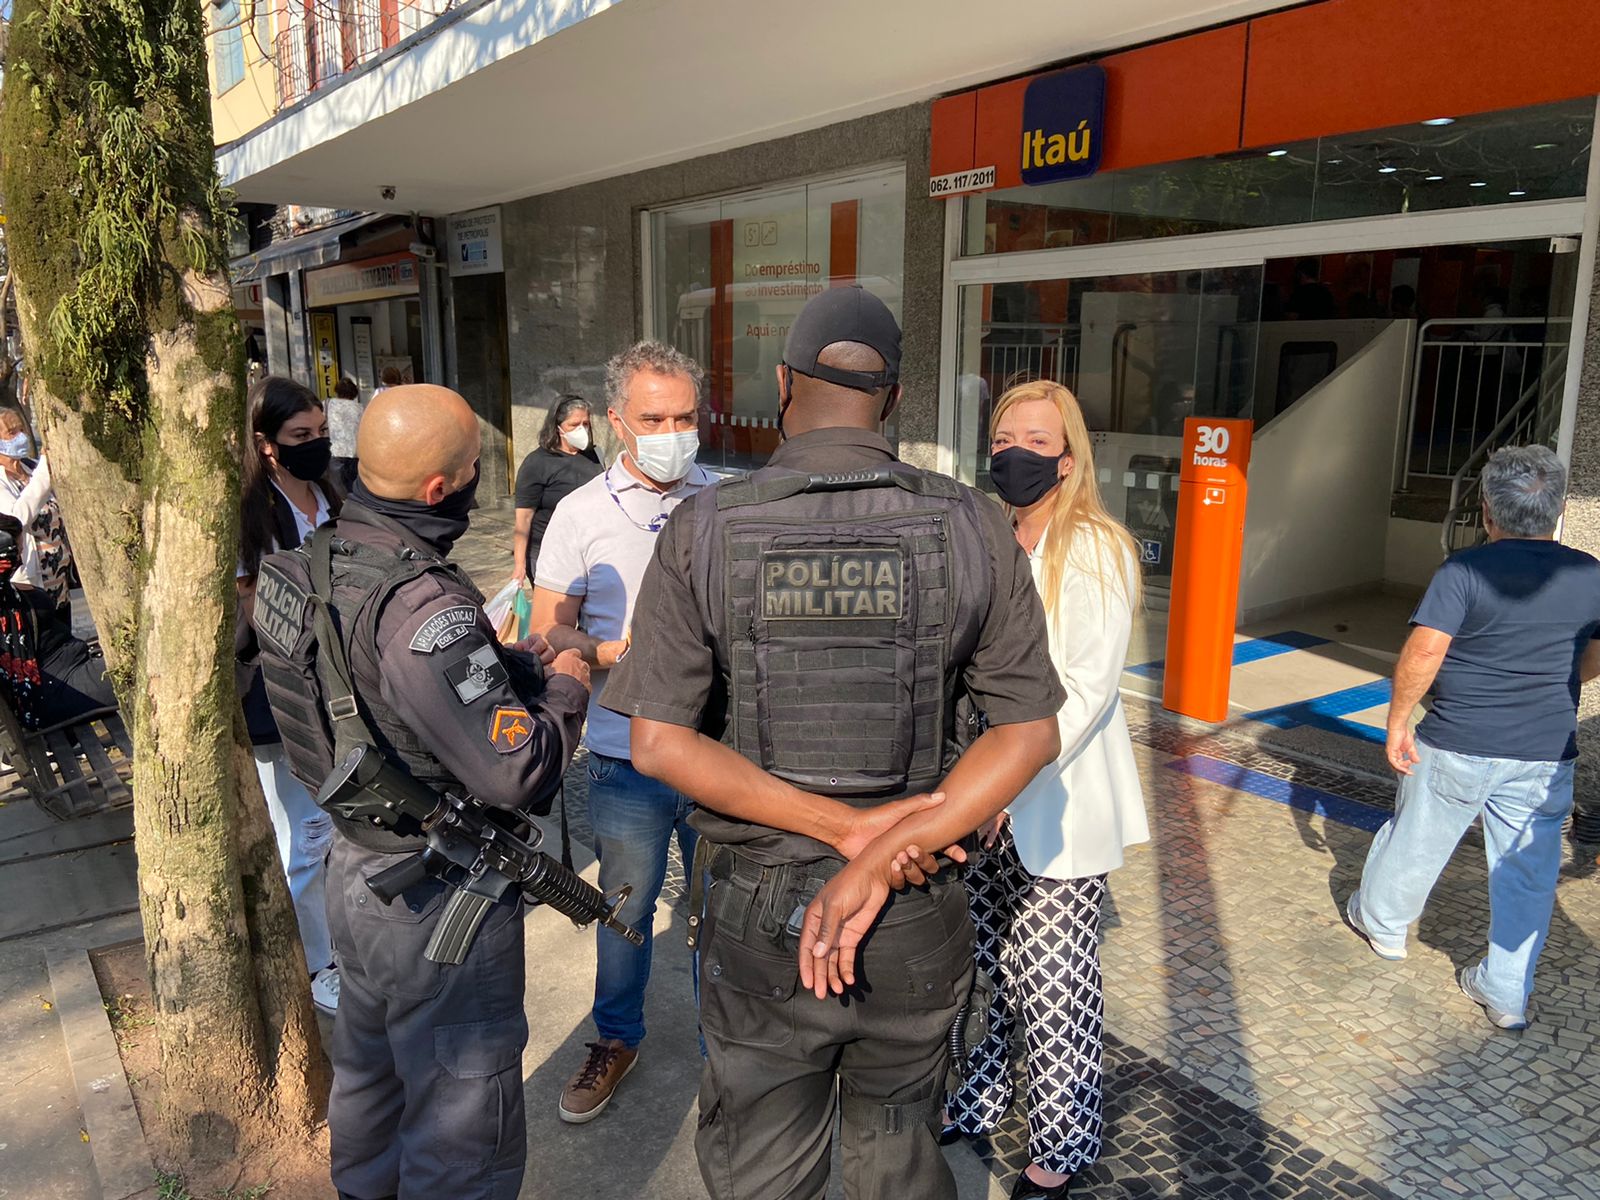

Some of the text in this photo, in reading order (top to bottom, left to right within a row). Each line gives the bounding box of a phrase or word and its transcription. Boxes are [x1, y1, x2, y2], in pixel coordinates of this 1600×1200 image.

[1022, 119, 1091, 170] Itaú
[745, 260, 820, 278] Do empréstimo
[745, 282, 823, 297] ao investimento
[746, 323, 769, 340] Aqui
[1194, 425, 1230, 454] 30
[1193, 452, 1228, 468] horas
[766, 555, 896, 588] POLÍCIA
[257, 571, 301, 626] POLÍCIA
[766, 589, 897, 616] MILITAR
[254, 596, 298, 653] MILITAR
[416, 609, 473, 649] APLICAÇÕES TÁTICAS
